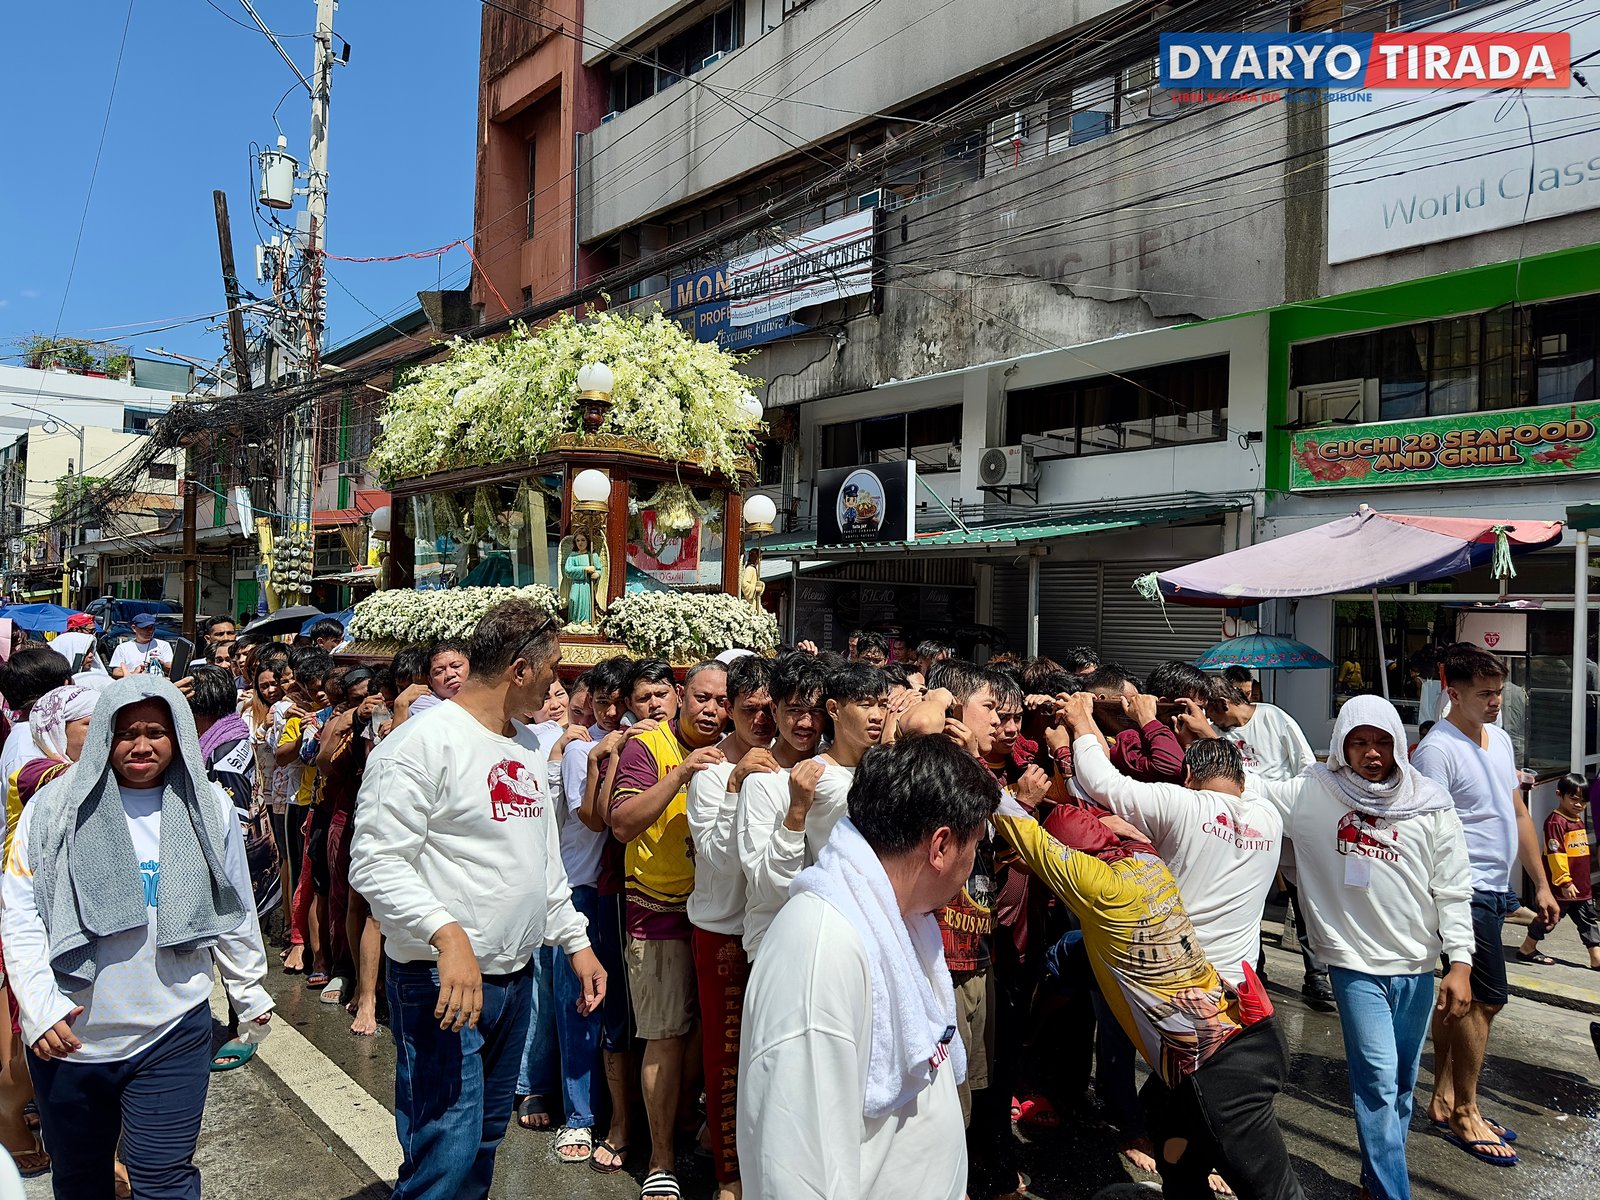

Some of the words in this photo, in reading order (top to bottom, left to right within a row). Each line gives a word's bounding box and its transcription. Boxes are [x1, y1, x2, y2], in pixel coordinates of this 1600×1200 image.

[1382, 177, 1486, 230] World
[1318, 436, 1398, 459] CUCHI
[1403, 434, 1436, 451] 28
[1445, 420, 1590, 448] SEAFOOD
[1373, 451, 1432, 470] AND
[1438, 444, 1520, 465] GRILL
[490, 800, 508, 822] El
[1202, 822, 1234, 844] CALLE
[944, 907, 976, 934] JESUS
